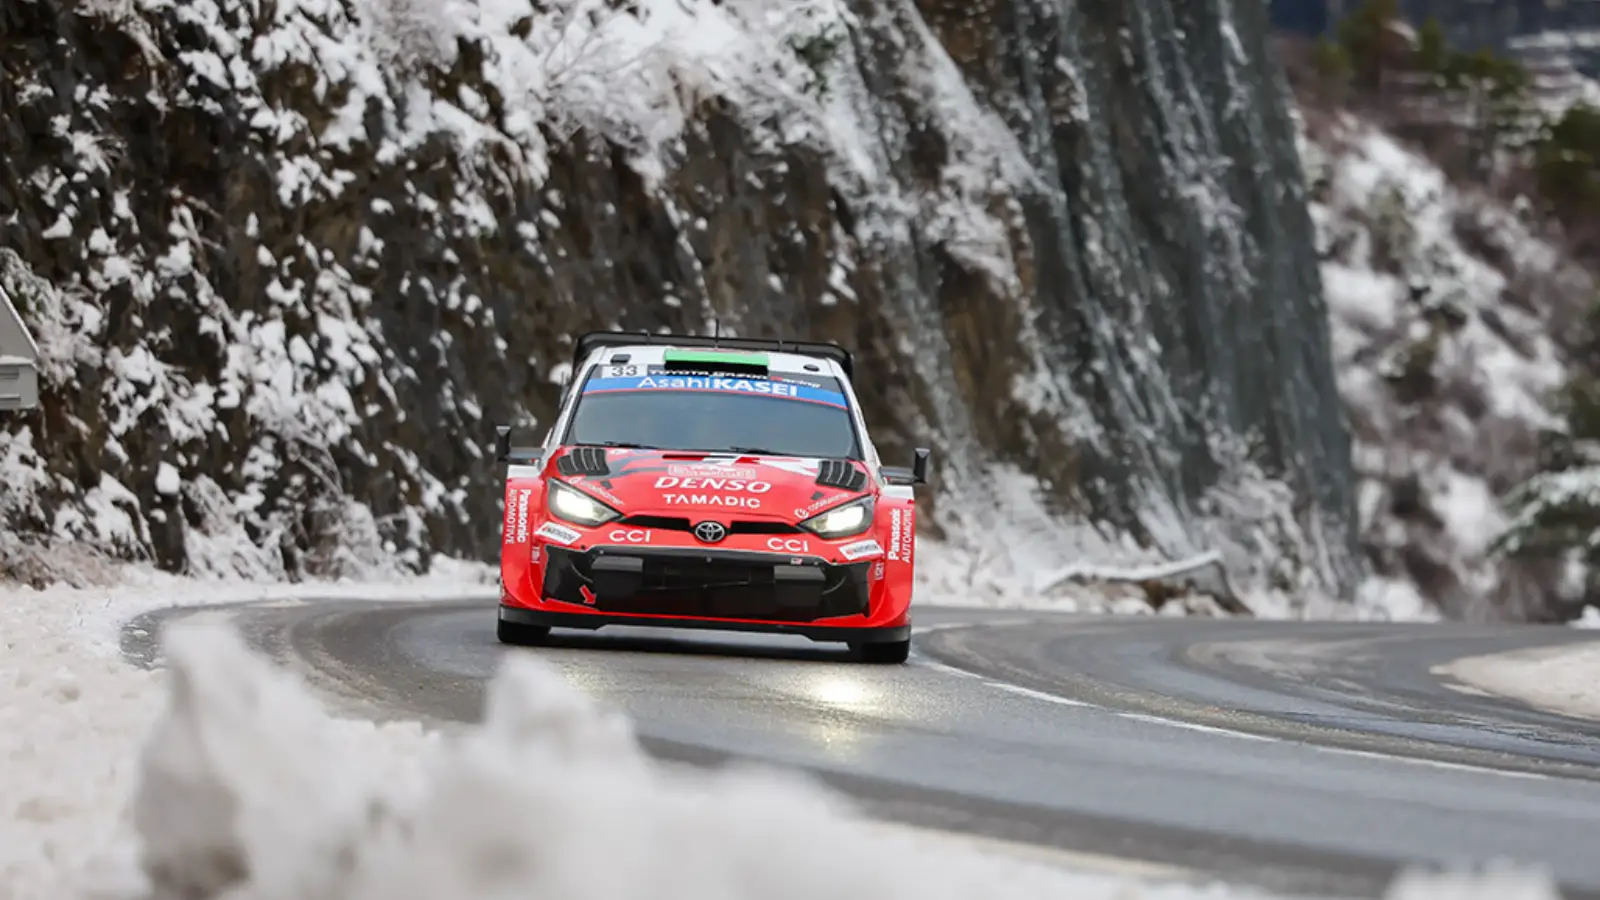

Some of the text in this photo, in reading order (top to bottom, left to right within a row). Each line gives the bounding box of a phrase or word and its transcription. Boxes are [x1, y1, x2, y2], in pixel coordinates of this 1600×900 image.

[611, 365, 638, 377] 33
[654, 476, 772, 494] DENSO
[662, 493, 761, 508] TAMADIC
[505, 489, 518, 544] AUTOMOTIVE
[517, 489, 532, 543] Panasonic
[609, 529, 651, 542] CCI
[888, 508, 901, 560] Panasonic
[902, 509, 913, 564] AUTOMOTIVE
[767, 537, 809, 552] CCI
